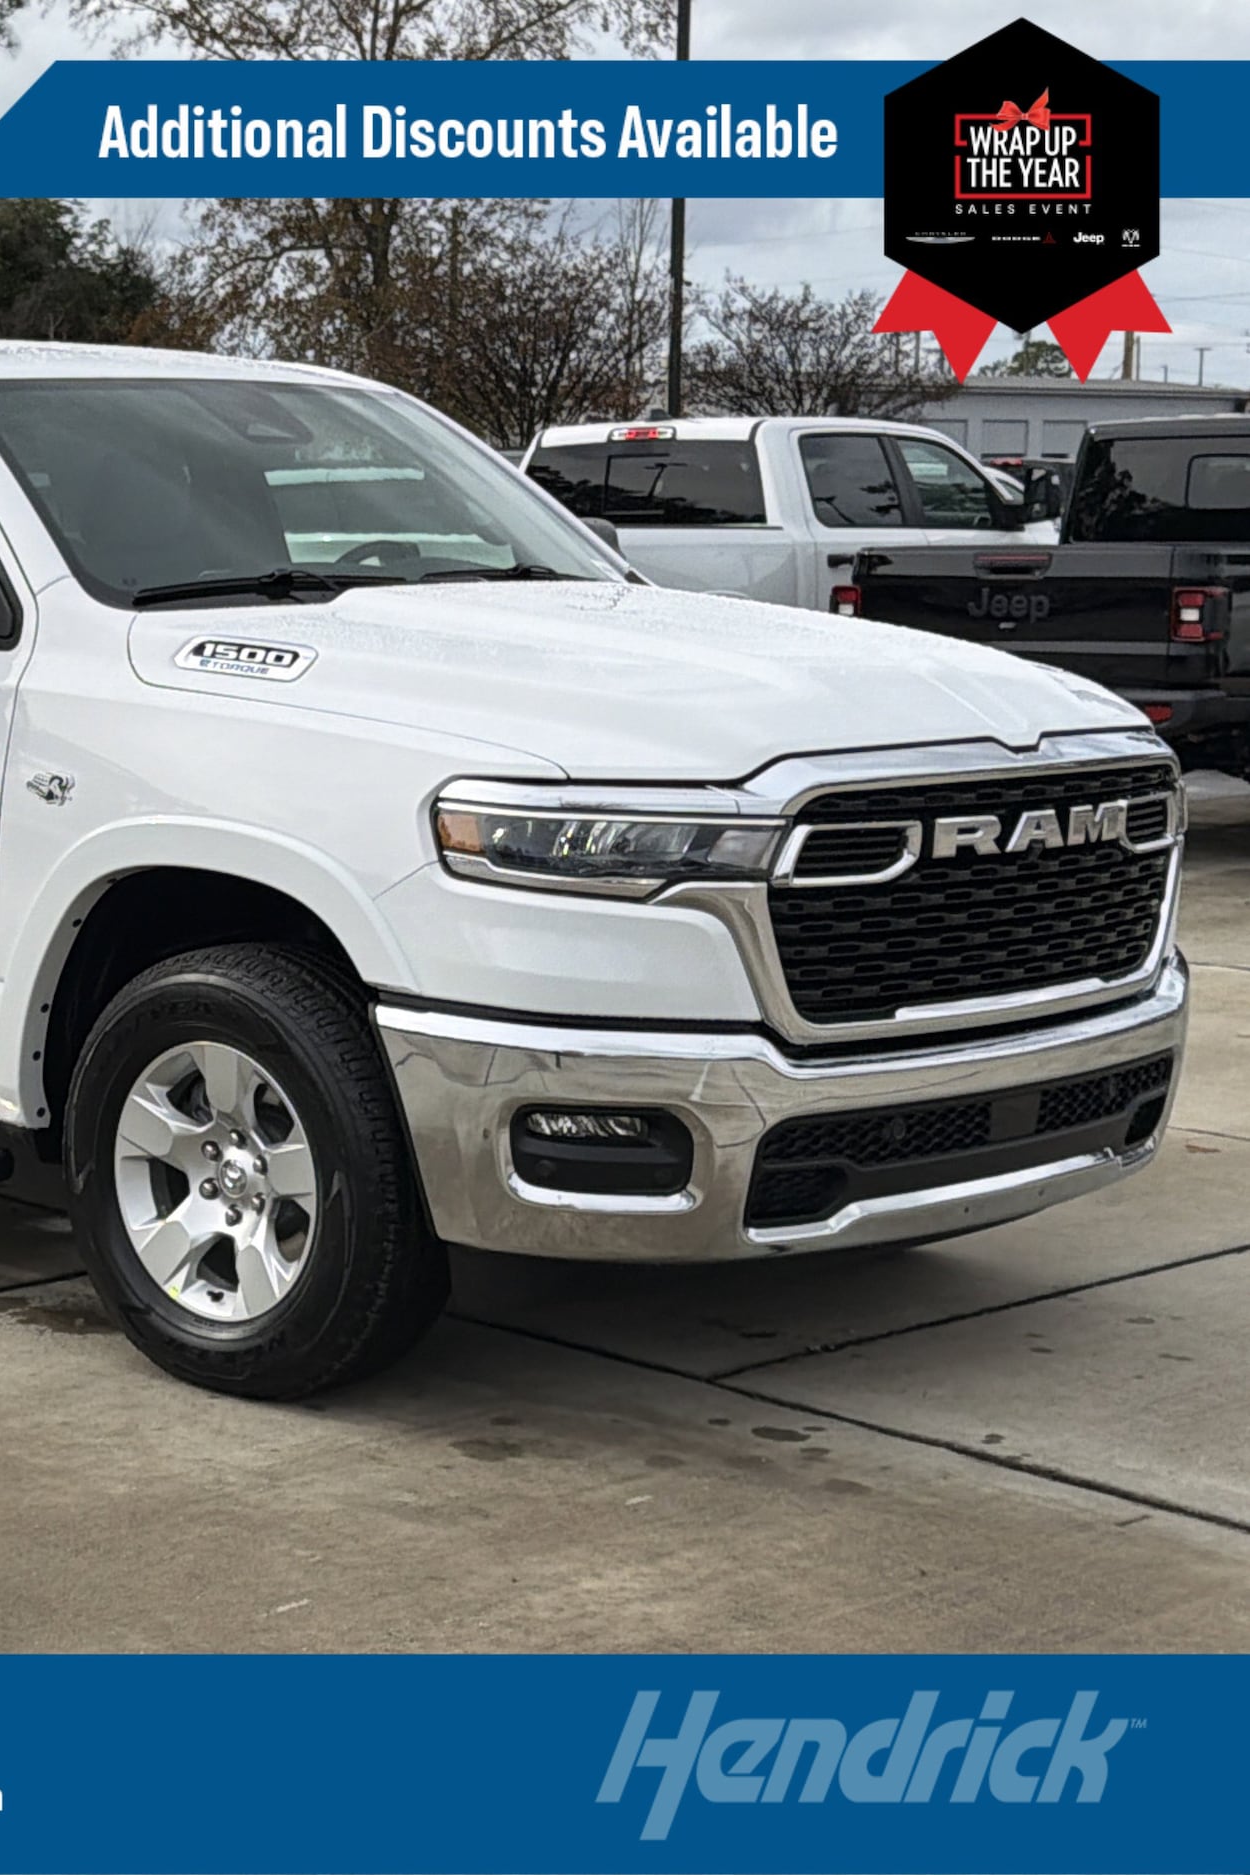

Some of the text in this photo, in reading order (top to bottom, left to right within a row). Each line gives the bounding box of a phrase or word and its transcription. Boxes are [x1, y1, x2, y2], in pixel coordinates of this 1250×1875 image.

[968, 587, 1050, 622] Jeep
[202, 642, 294, 667] 1500
[931, 799, 1127, 859] RAM
